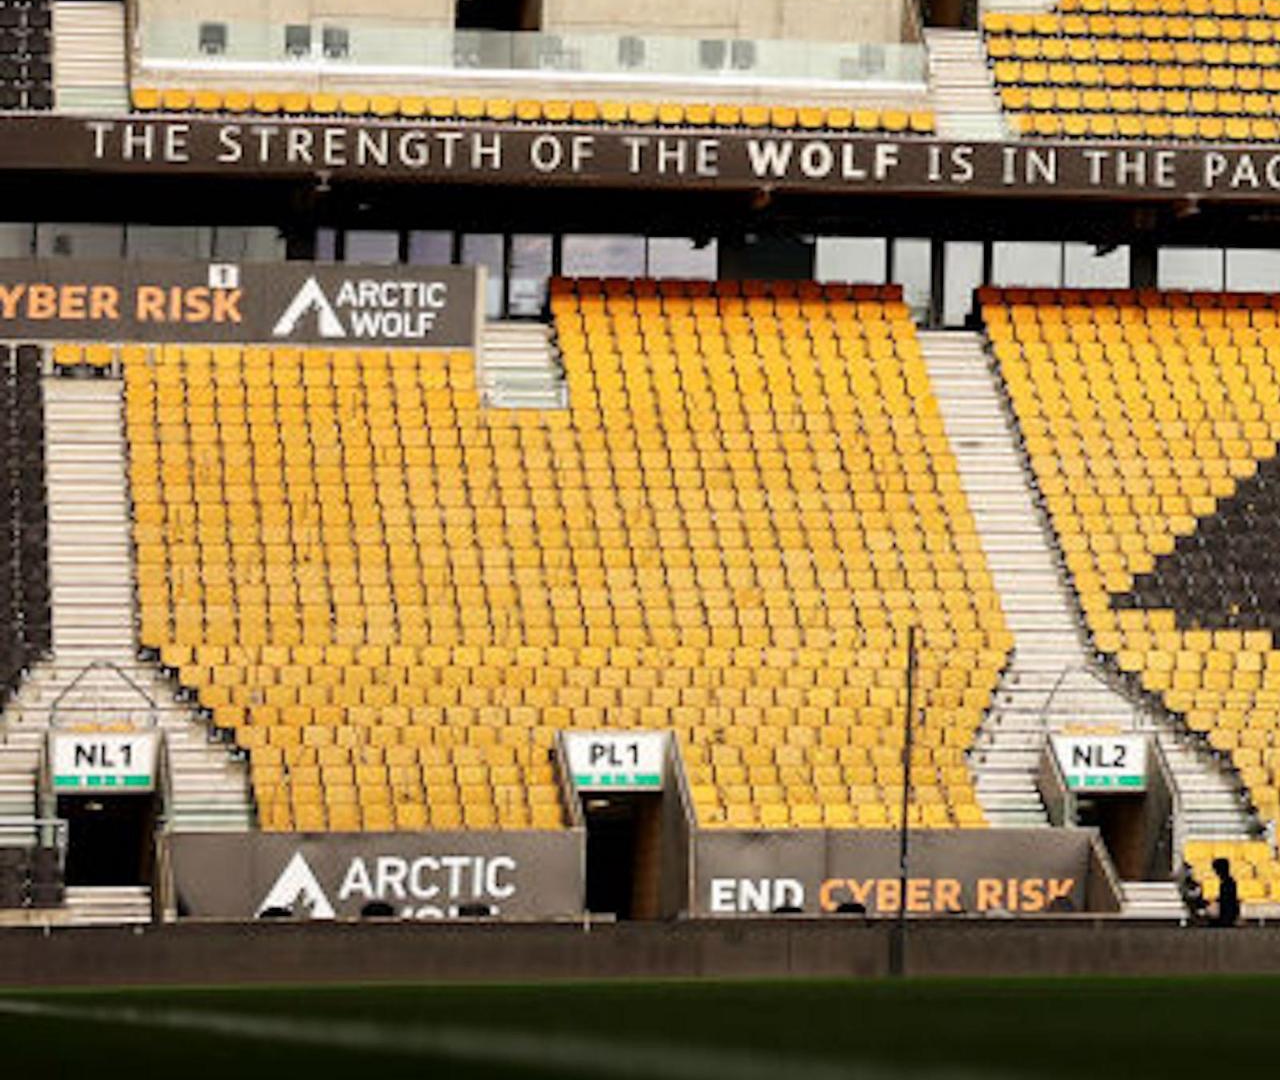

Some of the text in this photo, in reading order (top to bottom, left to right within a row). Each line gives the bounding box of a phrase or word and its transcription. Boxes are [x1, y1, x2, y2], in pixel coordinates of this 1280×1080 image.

[86, 121, 189, 162] THE
[217, 125, 501, 170] STRENGTH
[529, 134, 595, 173] OF
[621, 136, 719, 176] THE
[746, 139, 899, 180] WOLF
[927, 146, 974, 182] IS
[1002, 147, 1058, 185] IN
[1082, 150, 1177, 188] THE
[136, 285, 242, 322] RISK
[336, 281, 446, 308] ARCTIC
[352, 311, 436, 338] WOLF
[75, 743, 131, 767] NL1
[589, 743, 638, 766] PL1
[1072, 745, 1126, 767] NL2
[338, 856, 517, 900] ARCTIC
[710, 878, 1074, 911] END CYBER RISK
